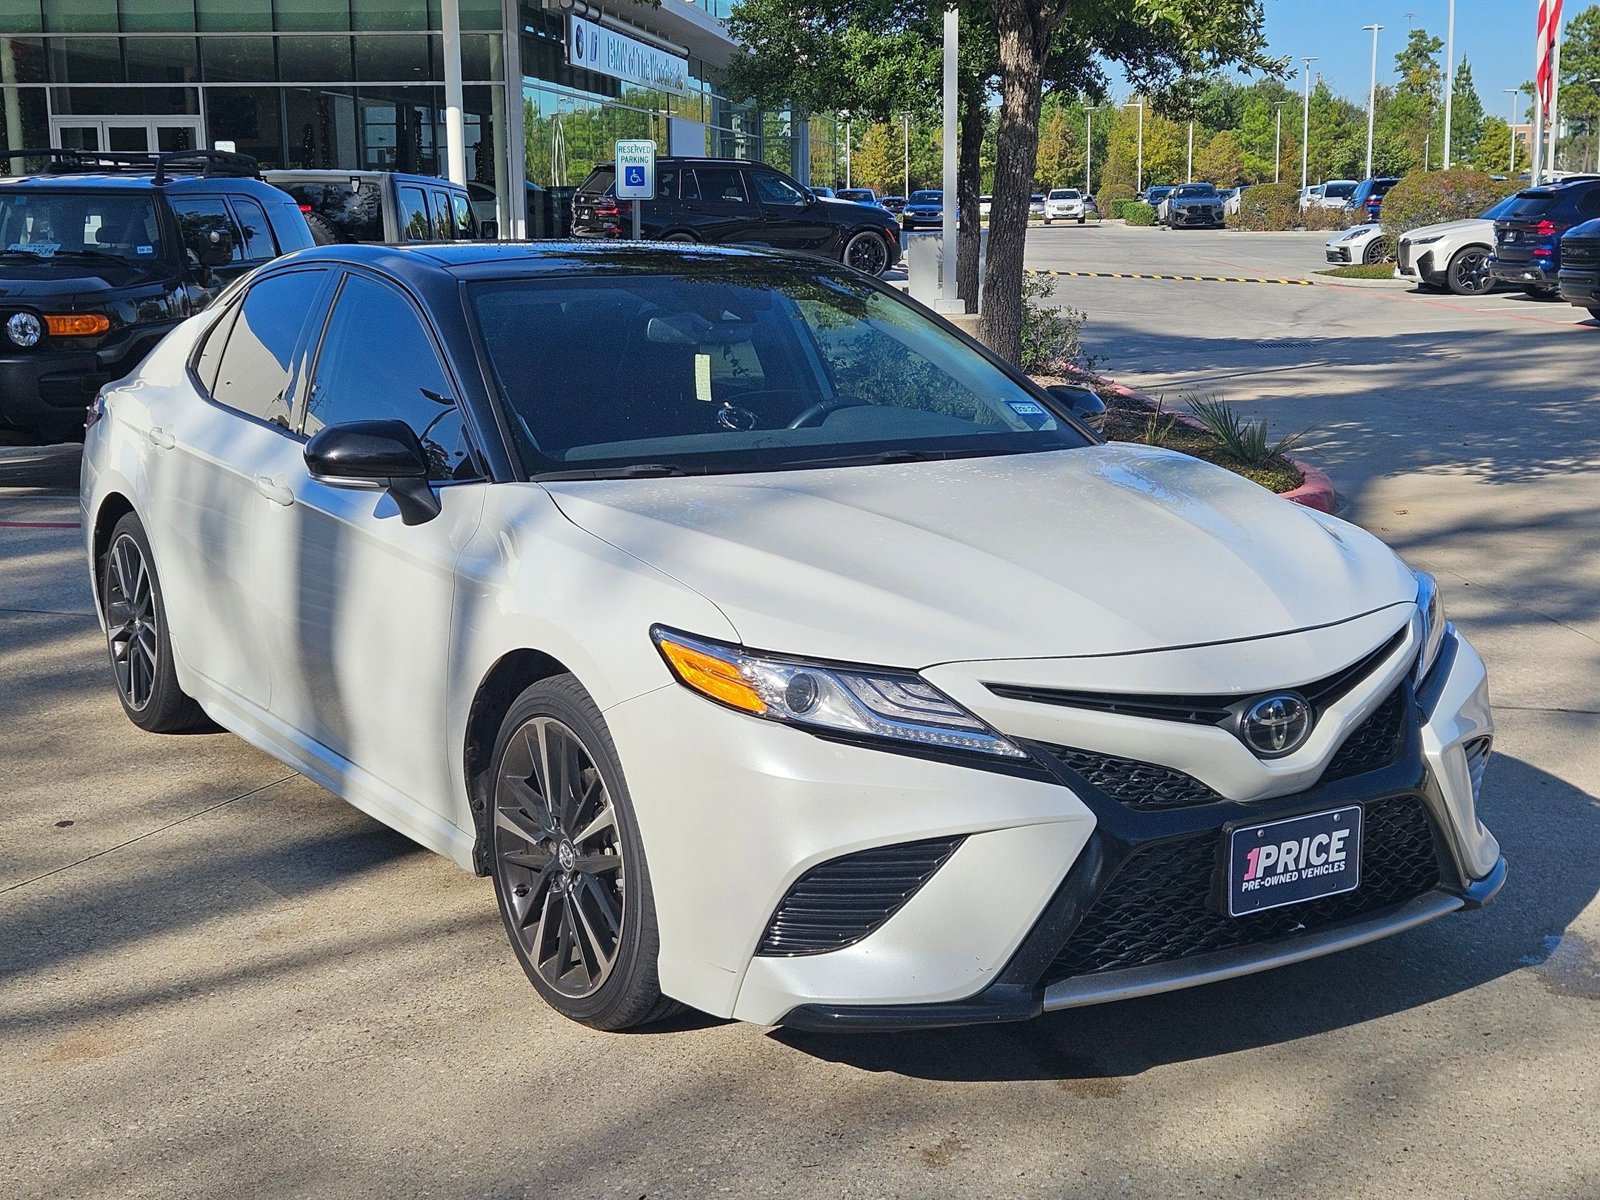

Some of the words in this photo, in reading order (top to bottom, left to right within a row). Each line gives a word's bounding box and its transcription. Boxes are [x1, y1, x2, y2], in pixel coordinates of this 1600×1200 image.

[607, 37, 628, 73] BMW
[628, 46, 637, 76] of
[637, 47, 650, 80] The
[618, 145, 651, 154] RESERVED
[620, 155, 649, 164] PARKING
[1243, 829, 1350, 881] 1PRICE
[1241, 871, 1299, 892] PRE-OWNED
[1301, 861, 1346, 879] VEHICLES
